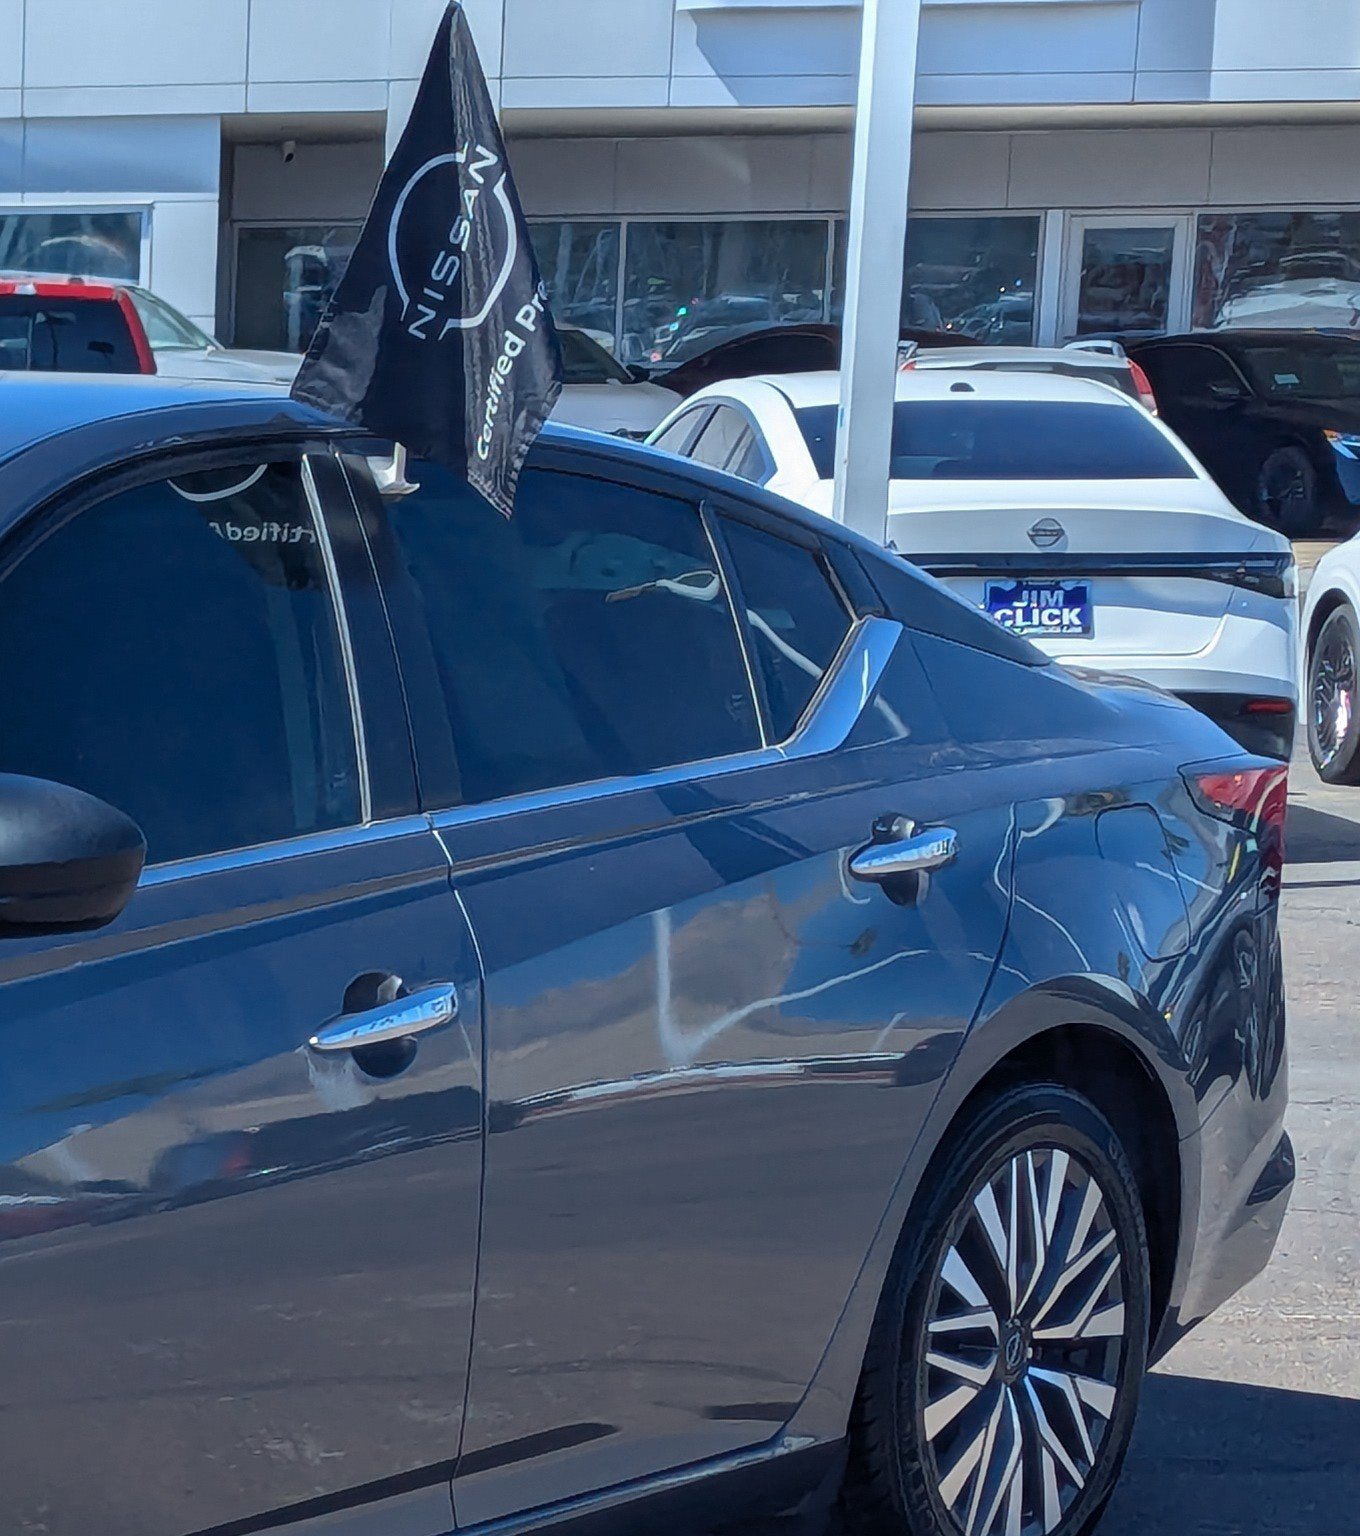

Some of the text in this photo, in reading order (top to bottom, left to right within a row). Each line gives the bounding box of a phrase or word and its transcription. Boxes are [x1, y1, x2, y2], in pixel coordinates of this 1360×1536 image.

[408, 144, 498, 340] NISSAN
[477, 330, 526, 461] Certified
[994, 607, 1082, 627] CLICK
[1012, 589, 1064, 607] JIM
